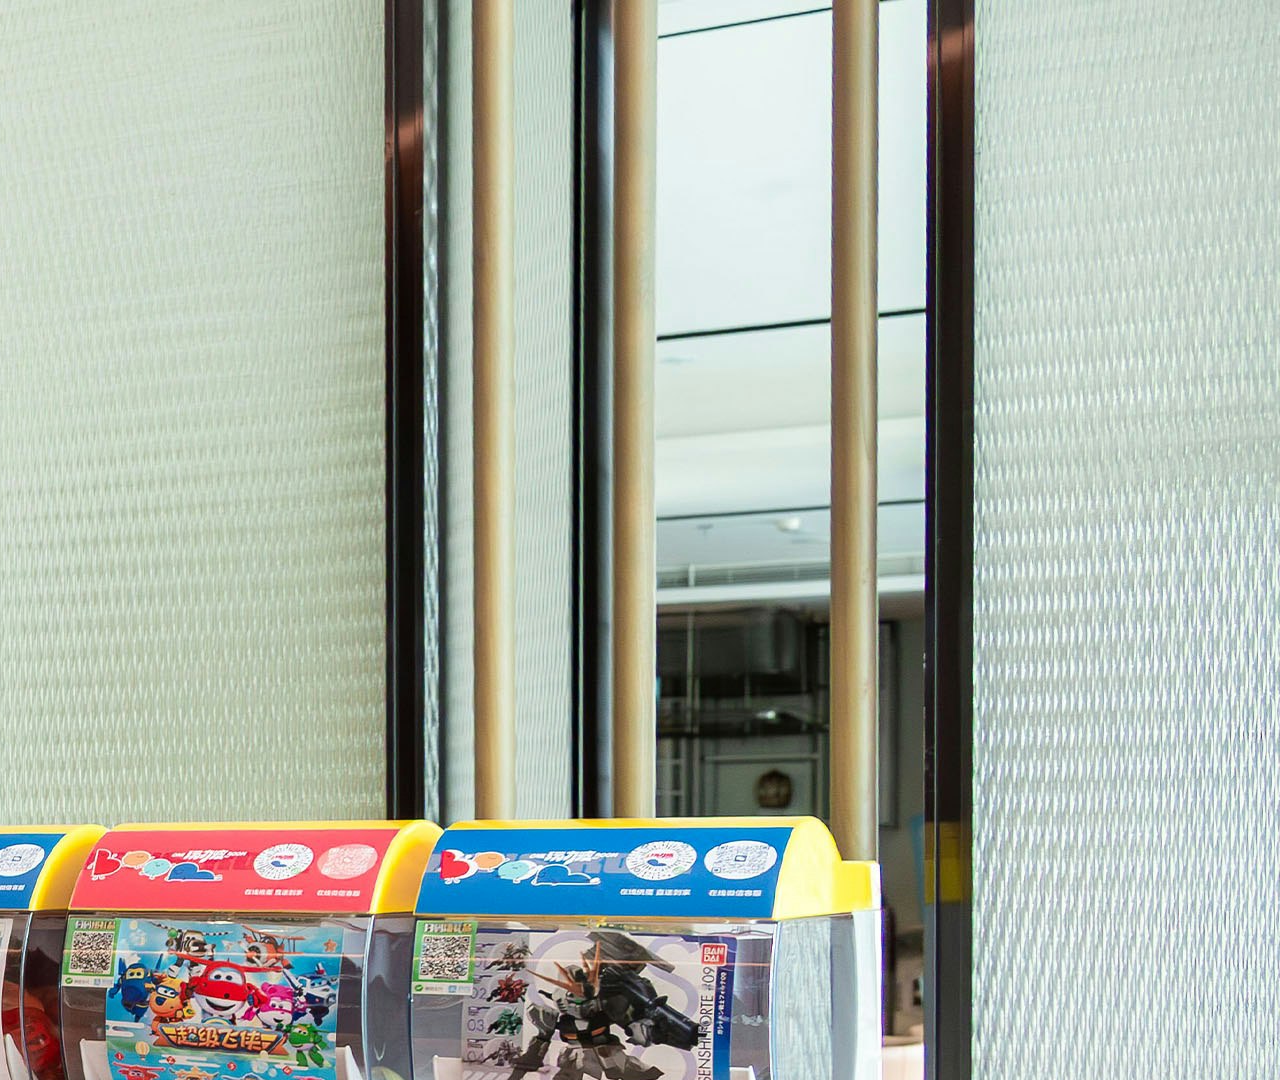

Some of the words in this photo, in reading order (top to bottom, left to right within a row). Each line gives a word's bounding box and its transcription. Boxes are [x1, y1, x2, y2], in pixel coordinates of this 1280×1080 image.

[704, 946, 725, 954] BAN
[704, 954, 721, 962] DAI
[467, 1019, 484, 1032] 03
[176, 1025, 261, 1050] 超级飞侠
